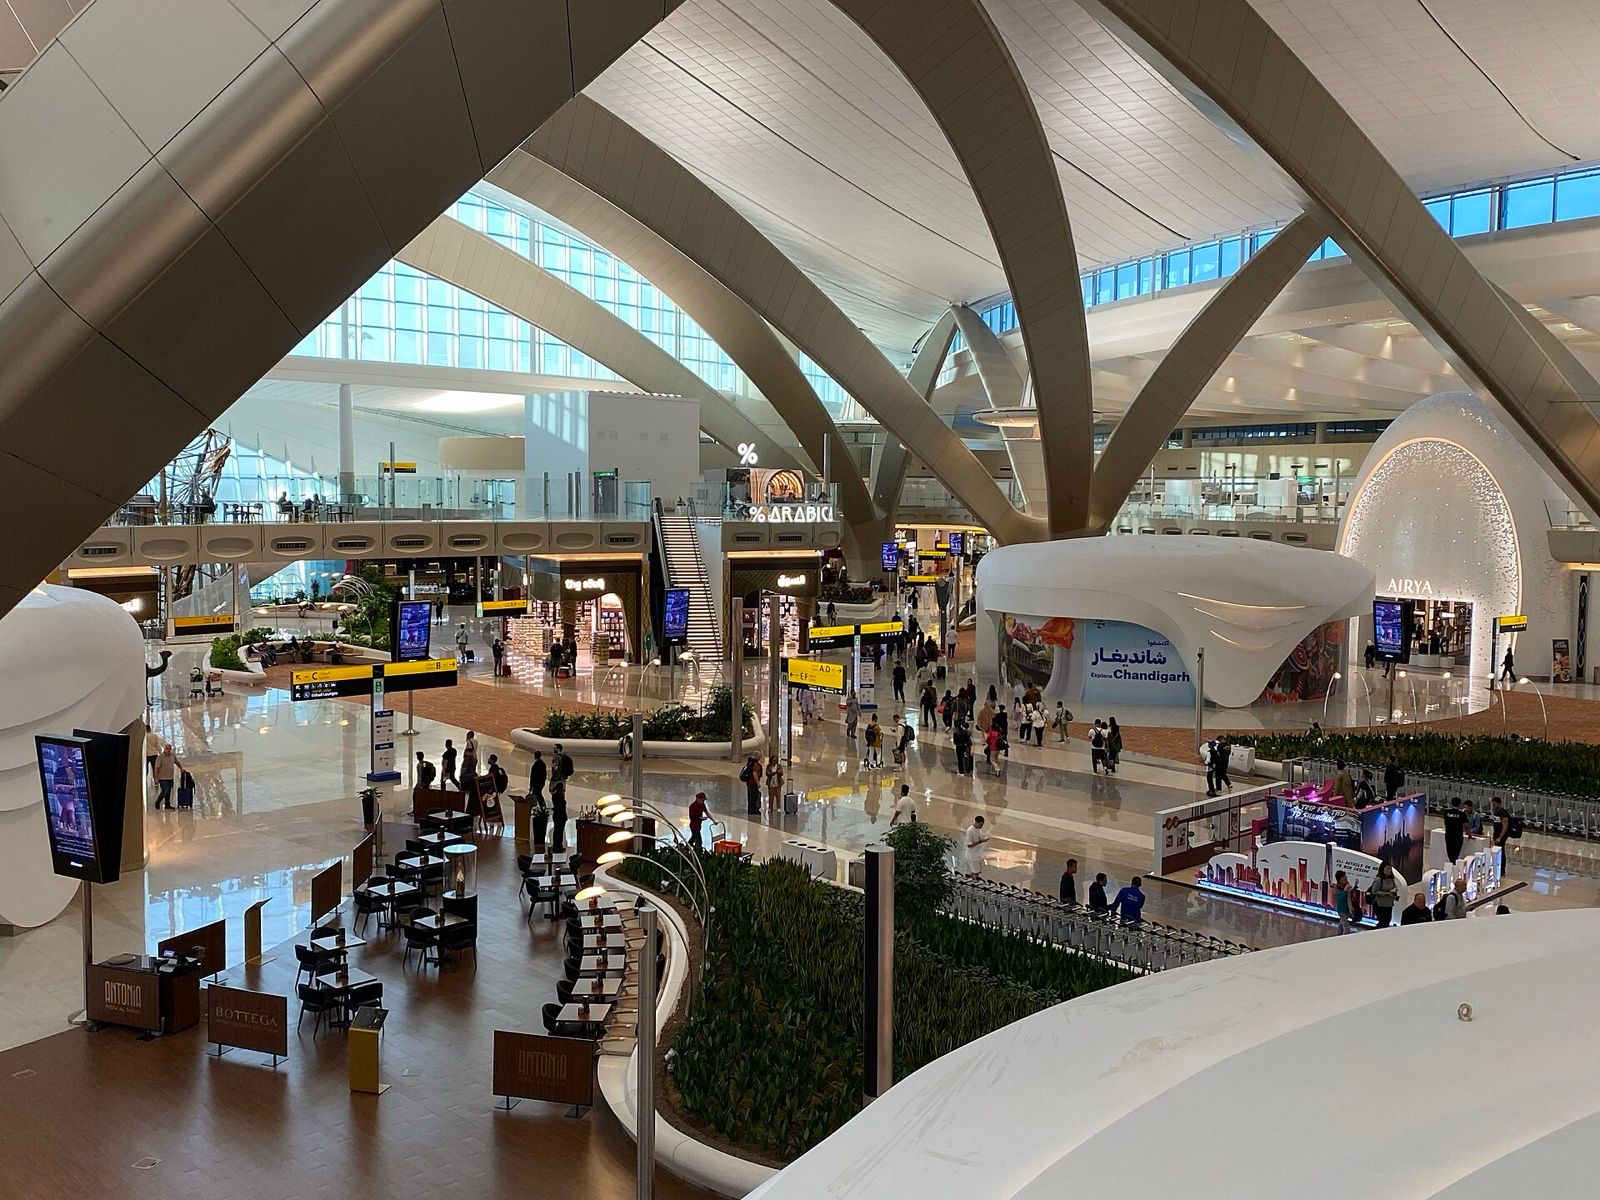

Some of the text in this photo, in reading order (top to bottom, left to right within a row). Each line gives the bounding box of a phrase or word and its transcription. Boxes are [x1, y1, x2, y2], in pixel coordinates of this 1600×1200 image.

[767, 505, 834, 523] ARABIC
[1387, 578, 1433, 594] AIRYA
[311, 671, 318, 680] C
[1091, 669, 1190, 684] Explore Chandigarh
[1301, 804, 1316, 812] TRIP
[215, 1006, 279, 1027] BOTTEGA
